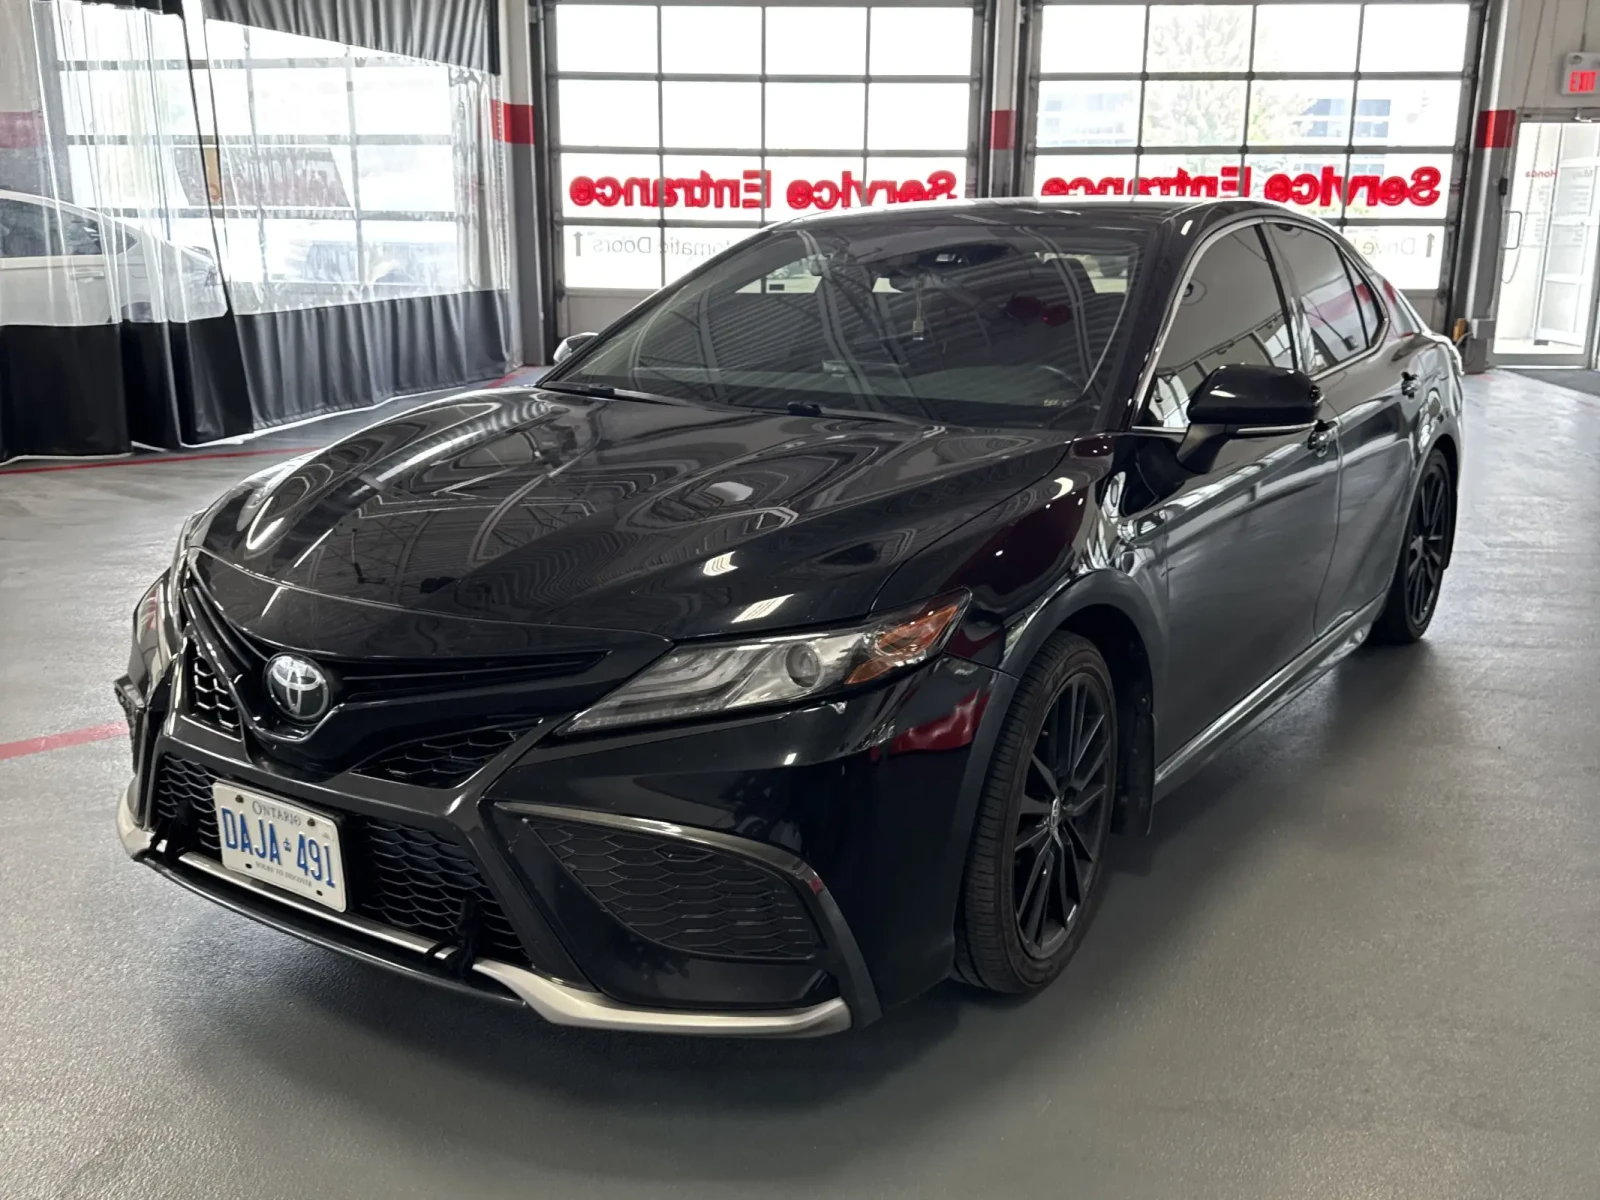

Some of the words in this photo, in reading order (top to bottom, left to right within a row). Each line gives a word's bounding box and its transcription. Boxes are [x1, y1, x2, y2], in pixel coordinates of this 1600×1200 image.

[1569, 71, 1597, 93] EXIT
[221, 807, 282, 866] DAJA
[297, 833, 336, 888] 491
